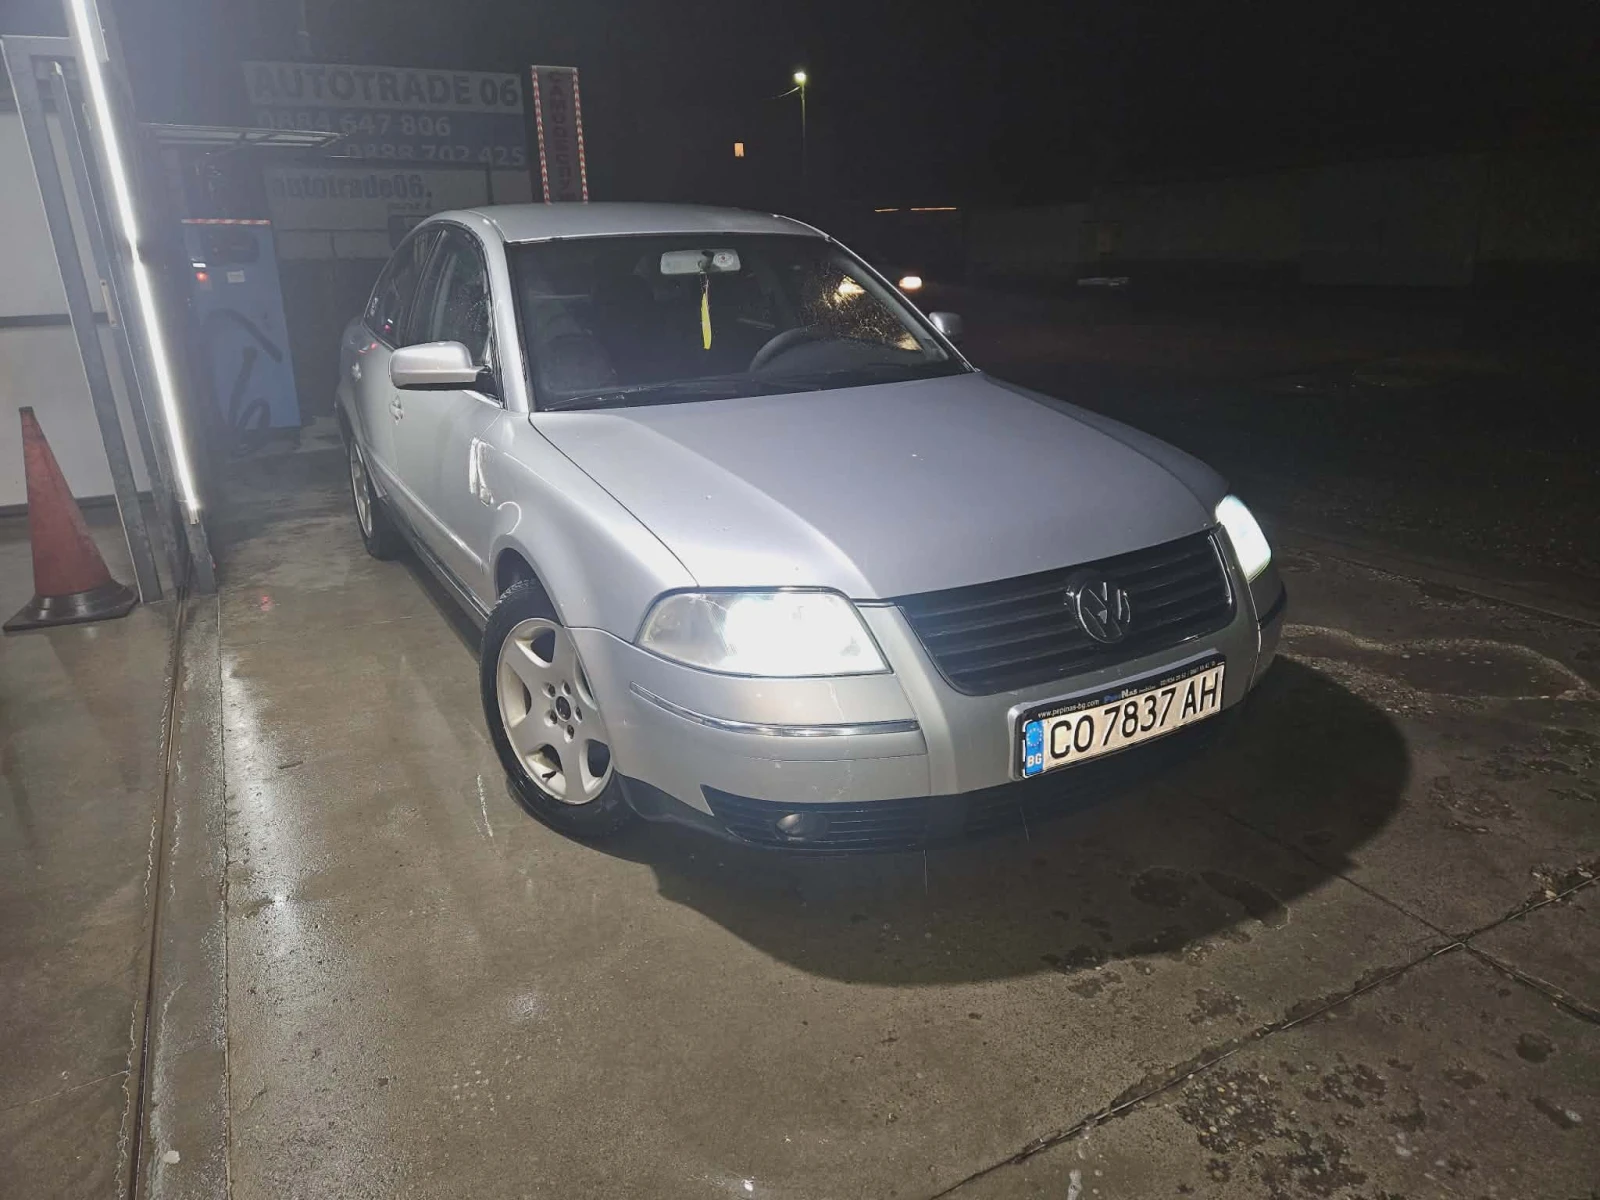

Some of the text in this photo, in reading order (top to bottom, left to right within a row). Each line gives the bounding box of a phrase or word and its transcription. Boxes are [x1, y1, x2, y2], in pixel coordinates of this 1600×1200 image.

[254, 66, 519, 107] AUTOTRADE 06
[340, 113, 391, 136] 647
[401, 116, 452, 138] 806
[1102, 687, 1177, 748] 7837
[1181, 672, 1220, 720] AH
[1027, 753, 1043, 768] BG
